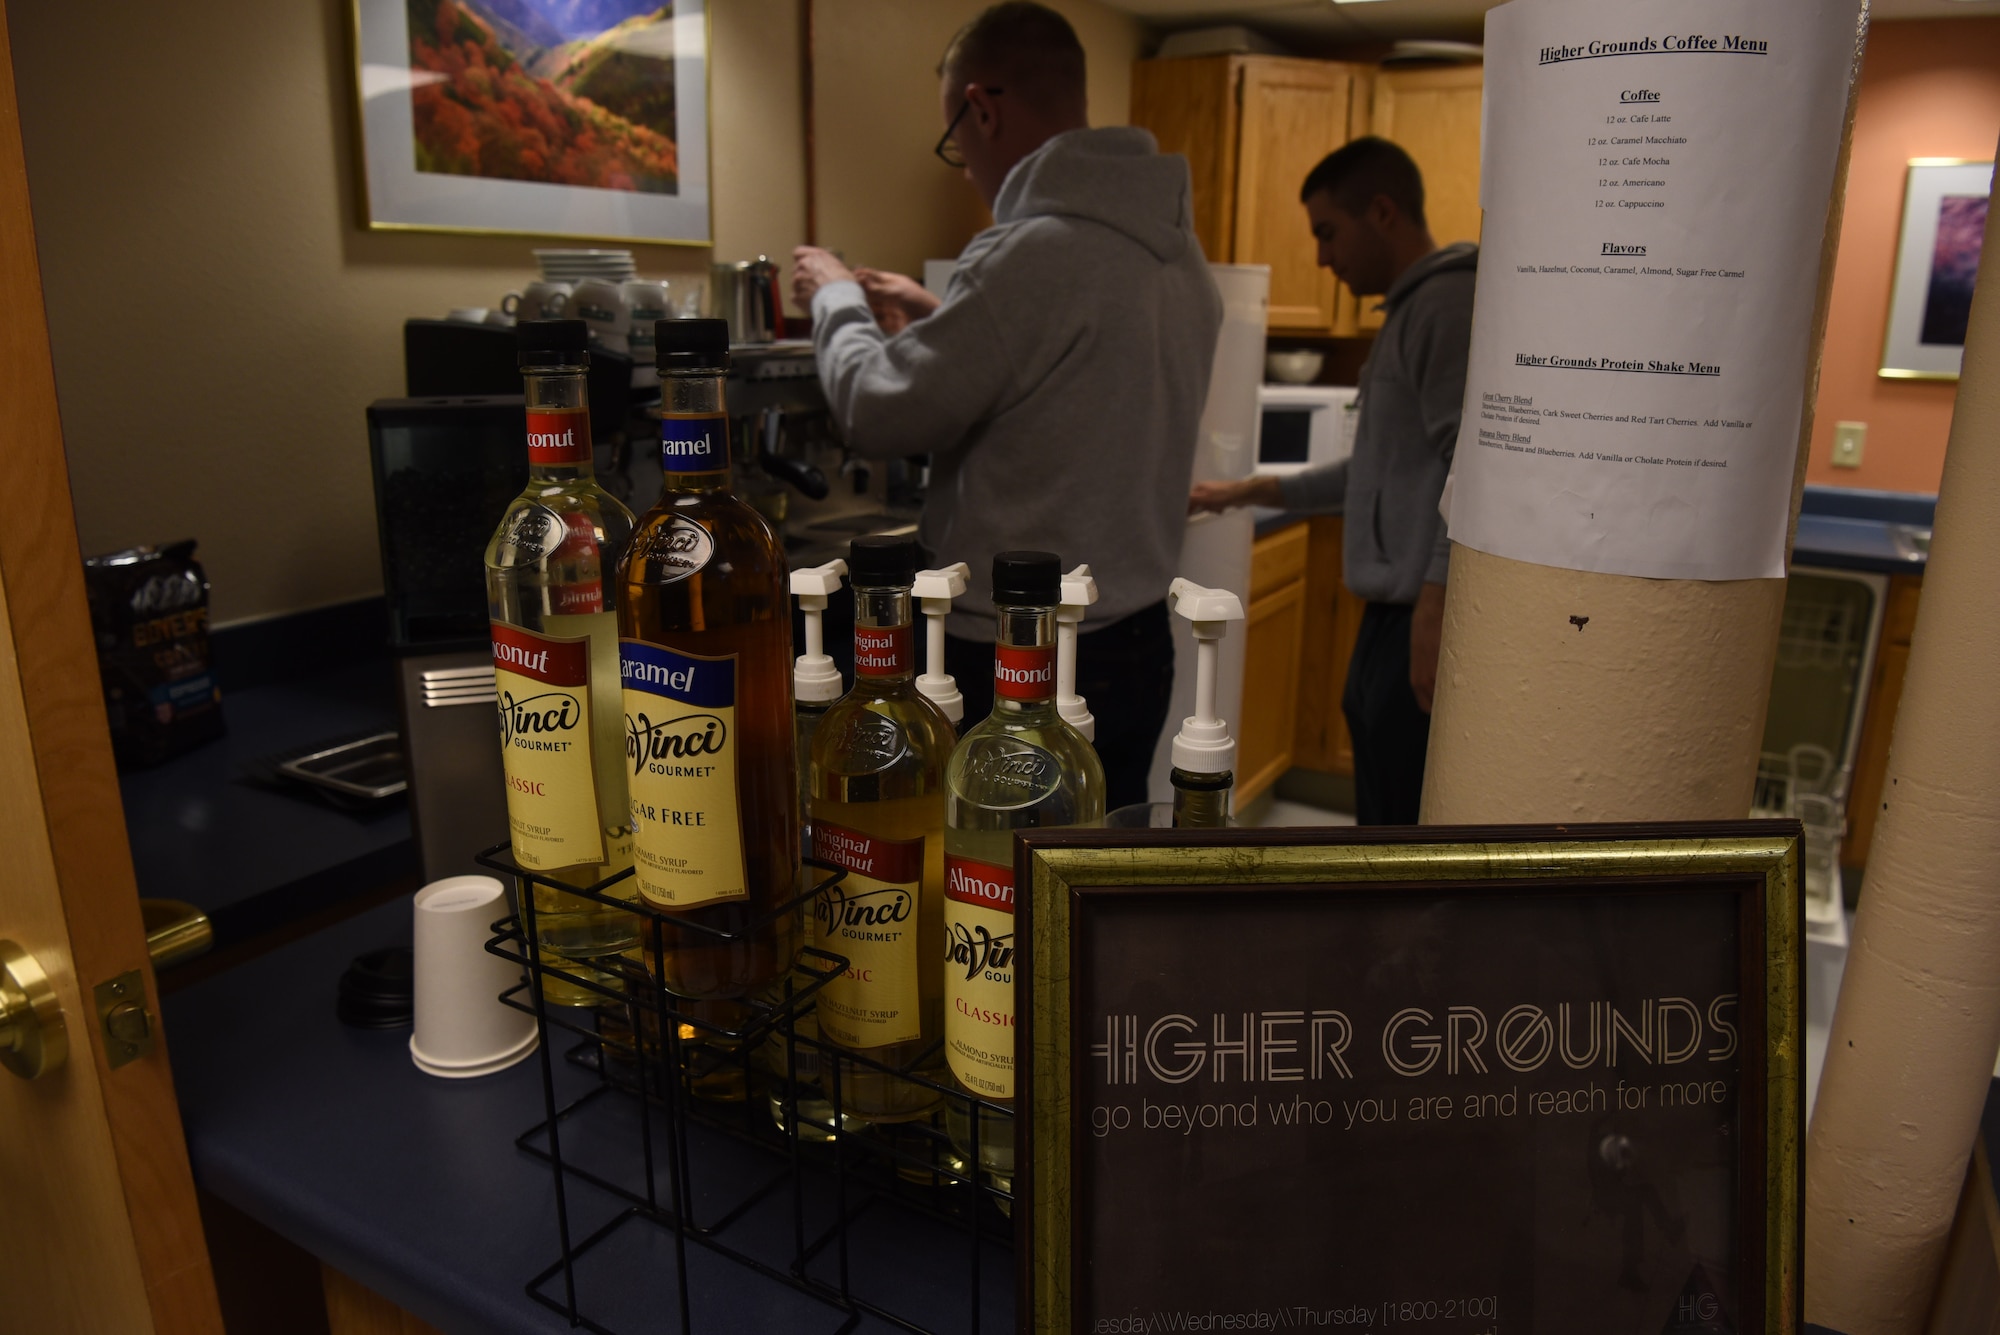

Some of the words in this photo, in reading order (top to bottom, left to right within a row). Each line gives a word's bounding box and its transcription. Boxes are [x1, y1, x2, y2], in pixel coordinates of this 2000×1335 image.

[1540, 45, 1584, 62] Higher
[1588, 37, 1657, 54] Grounds
[1663, 35, 1717, 50] Coffee
[1723, 35, 1767, 51] Menu
[1620, 89, 1660, 101] Coffee
[1606, 115, 1615, 124] 12
[1630, 114, 1649, 123] Cafe
[1651, 114, 1671, 123] Latte
[1588, 137, 1596, 146] 12
[1611, 136, 1643, 145] Caramel
[1645, 135, 1687, 145] Macchiato
[1599, 157, 1608, 166] 12
[1622, 157, 1640, 165] Cafe
[1642, 157, 1670, 165] Mocha
[1599, 179, 1607, 187] 12
[1622, 178, 1666, 187] Americano
[1595, 199, 1603, 208] 12
[1618, 199, 1665, 209] Cappuccino
[1601, 242, 1646, 254] Flavors
[1516, 265, 1537, 274] Vanilla,
[1538, 265, 1568, 274] Hazelnut,
[1570, 265, 1601, 275] Coconut,
[1604, 265, 1638, 275] Caramel,
[1640, 266, 1674, 277] Almond,
[1676, 267, 1698, 278] Sugar
[1700, 268, 1717, 277] Free
[1718, 269, 1744, 278] Carmel
[1515, 353, 1548, 366] Higher
[1550, 355, 1597, 368] Grounds
[1601, 358, 1644, 370] Protein
[1648, 360, 1684, 372] Shake
[1688, 362, 1720, 374] Menu
[1513, 395, 1533, 405] Blend
[1508, 405, 1541, 416] Blueberries,
[1560, 410, 1581, 419] Sweet
[1582, 412, 1613, 421] Cherries
[1615, 414, 1629, 423] and
[1631, 415, 1647, 423] Red
[1649, 416, 1664, 425] Tart
[1666, 417, 1698, 426] Cherries.
[1703, 419, 1718, 427] Add
[1720, 420, 1744, 428] Vanilla
[1512, 433, 1531, 443] Blend
[1525, 446, 1537, 454] and
[1579, 451, 1594, 460] Add
[1596, 453, 1622, 462] Vanilla
[1635, 455, 1664, 465] Cholate
[1665, 458, 1692, 467] Protein
[1701, 459, 1728, 468] desired.
[619, 652, 695, 693] aramel
[514, 737, 569, 752] GOURMET
[649, 762, 711, 778] GOURMET
[661, 808, 706, 826] FREE
[526, 823, 551, 836] SYRUP
[816, 826, 870, 854] Original
[659, 855, 688, 868] SYRUP
[675, 866, 704, 875] FLAVORED
[841, 928, 900, 942] GOURMET
[984, 970, 1011, 984] GOU
[869, 1010, 899, 1019] SYRUP
[956, 1039, 988, 1060] ALMOND
[1091, 1104, 1132, 1138] go
[1143, 1095, 1257, 1135] beyond
[1268, 1093, 1333, 1125] who
[1343, 1098, 1397, 1131] you
[1407, 1095, 1453, 1121] are
[1463, 1085, 1517, 1119] and
[1528, 1081, 1606, 1115] reach
[1615, 1079, 1651, 1110] for
[1660, 1079, 1727, 1107] more
[1382, 1295, 1497, 1326] [1800-2100]
